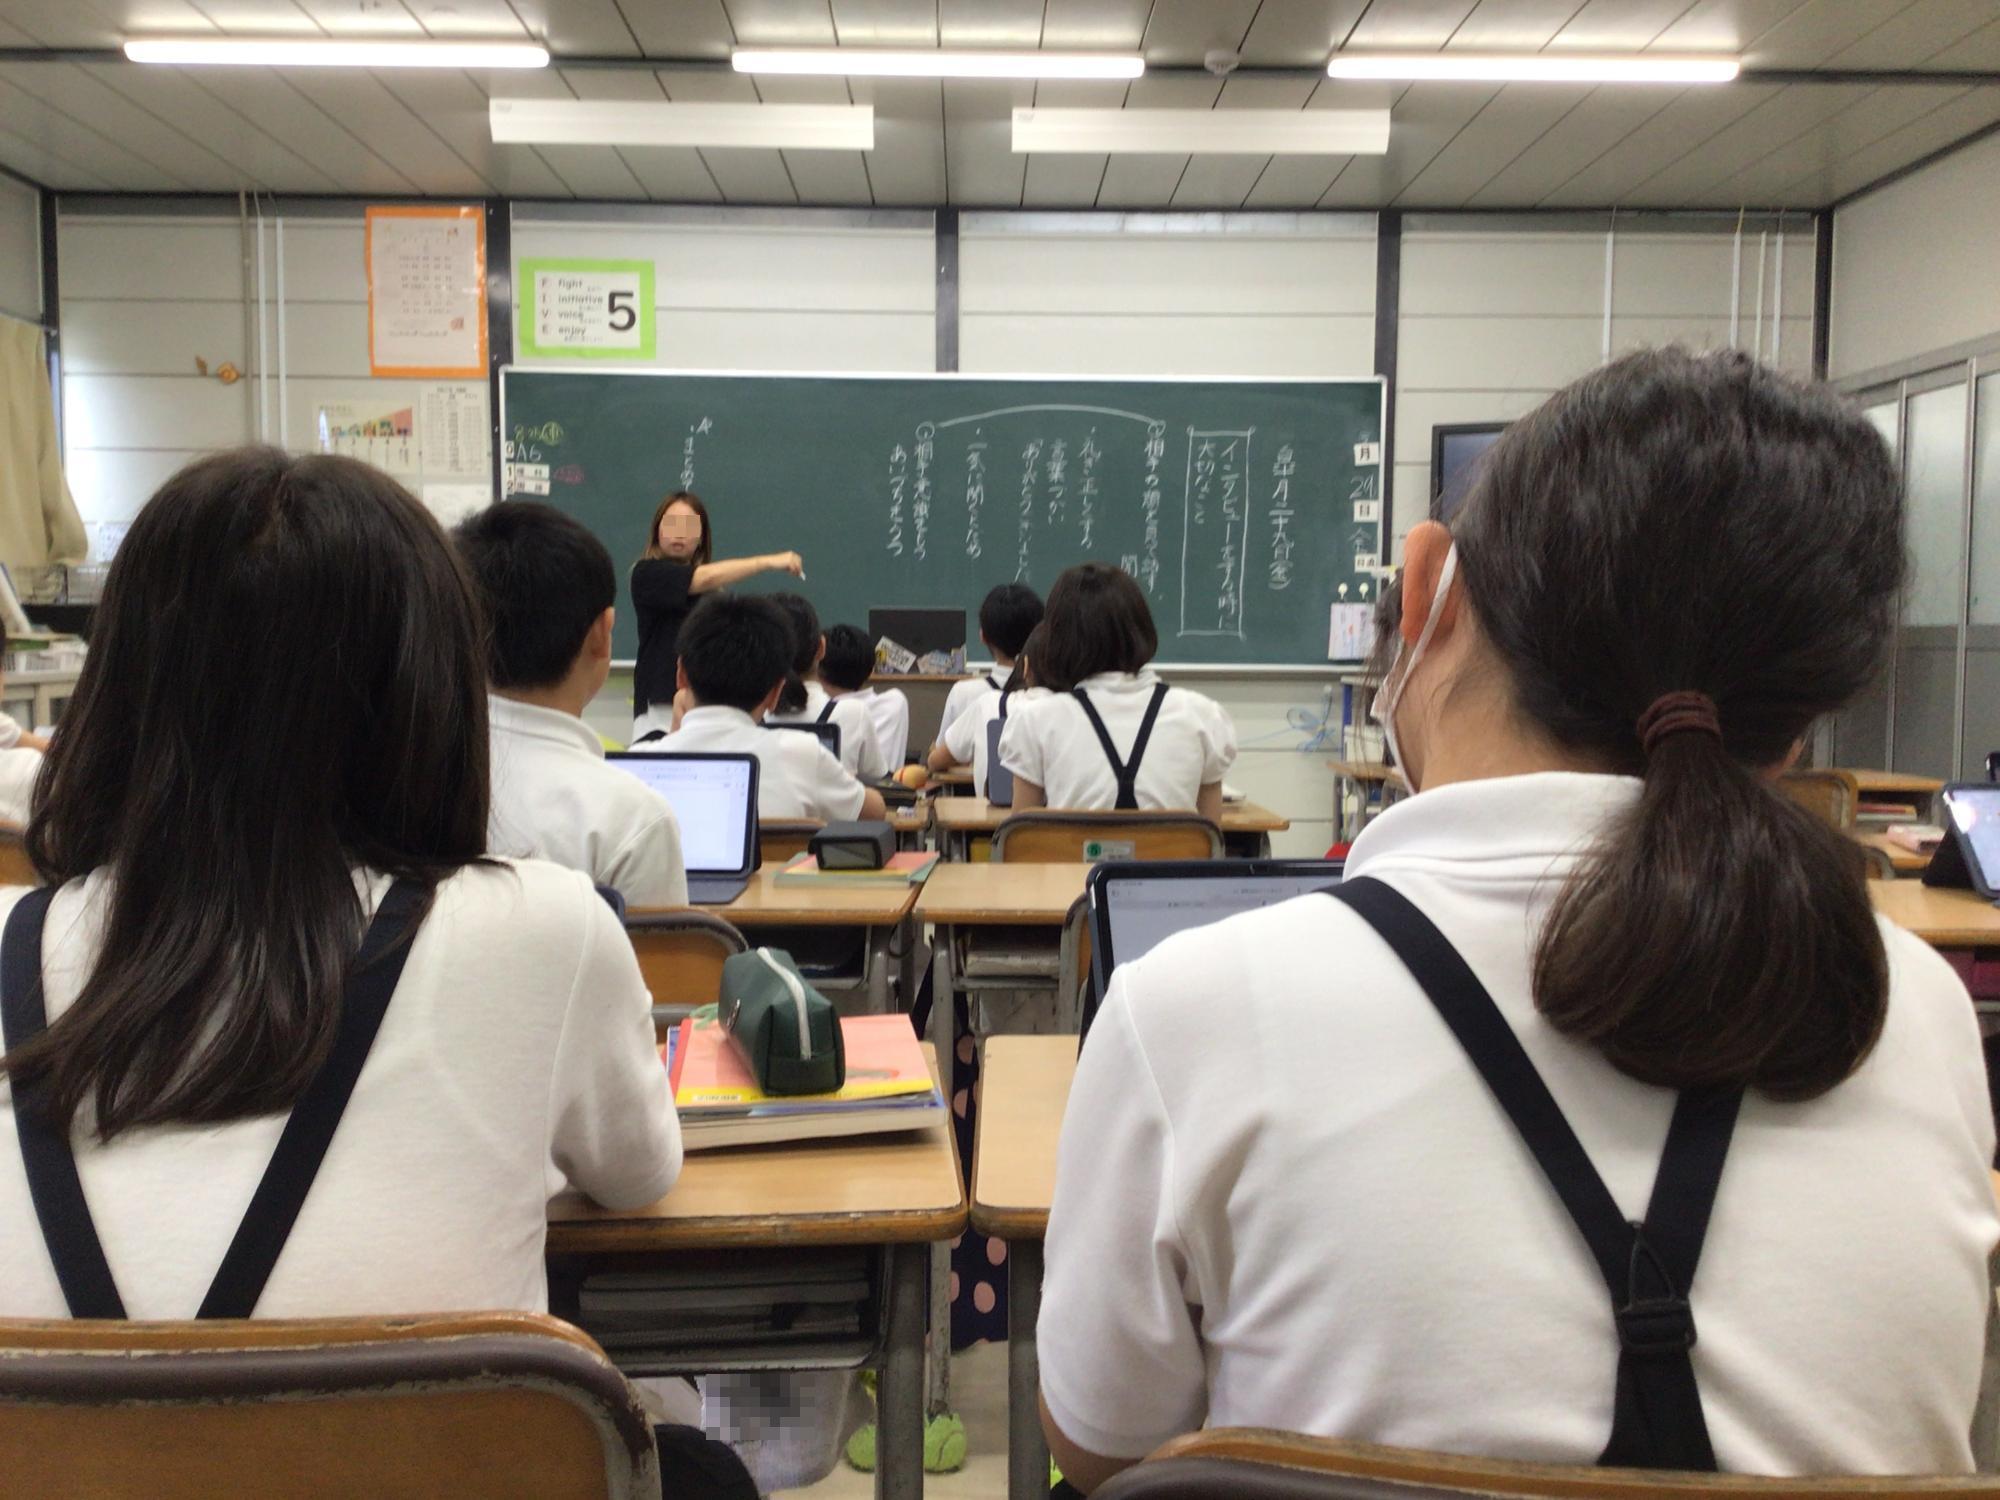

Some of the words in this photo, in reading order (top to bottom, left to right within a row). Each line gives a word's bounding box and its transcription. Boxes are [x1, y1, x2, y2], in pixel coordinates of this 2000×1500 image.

[558, 278, 584, 289] fight
[558, 294, 604, 305] initiative
[558, 310, 584, 319] voice
[608, 291, 636, 332] 5
[558, 325, 587, 337] enjoy
[1359, 446, 1371, 461] 月
[1349, 473, 1376, 501] 29
[1359, 502, 1370, 517] 日
